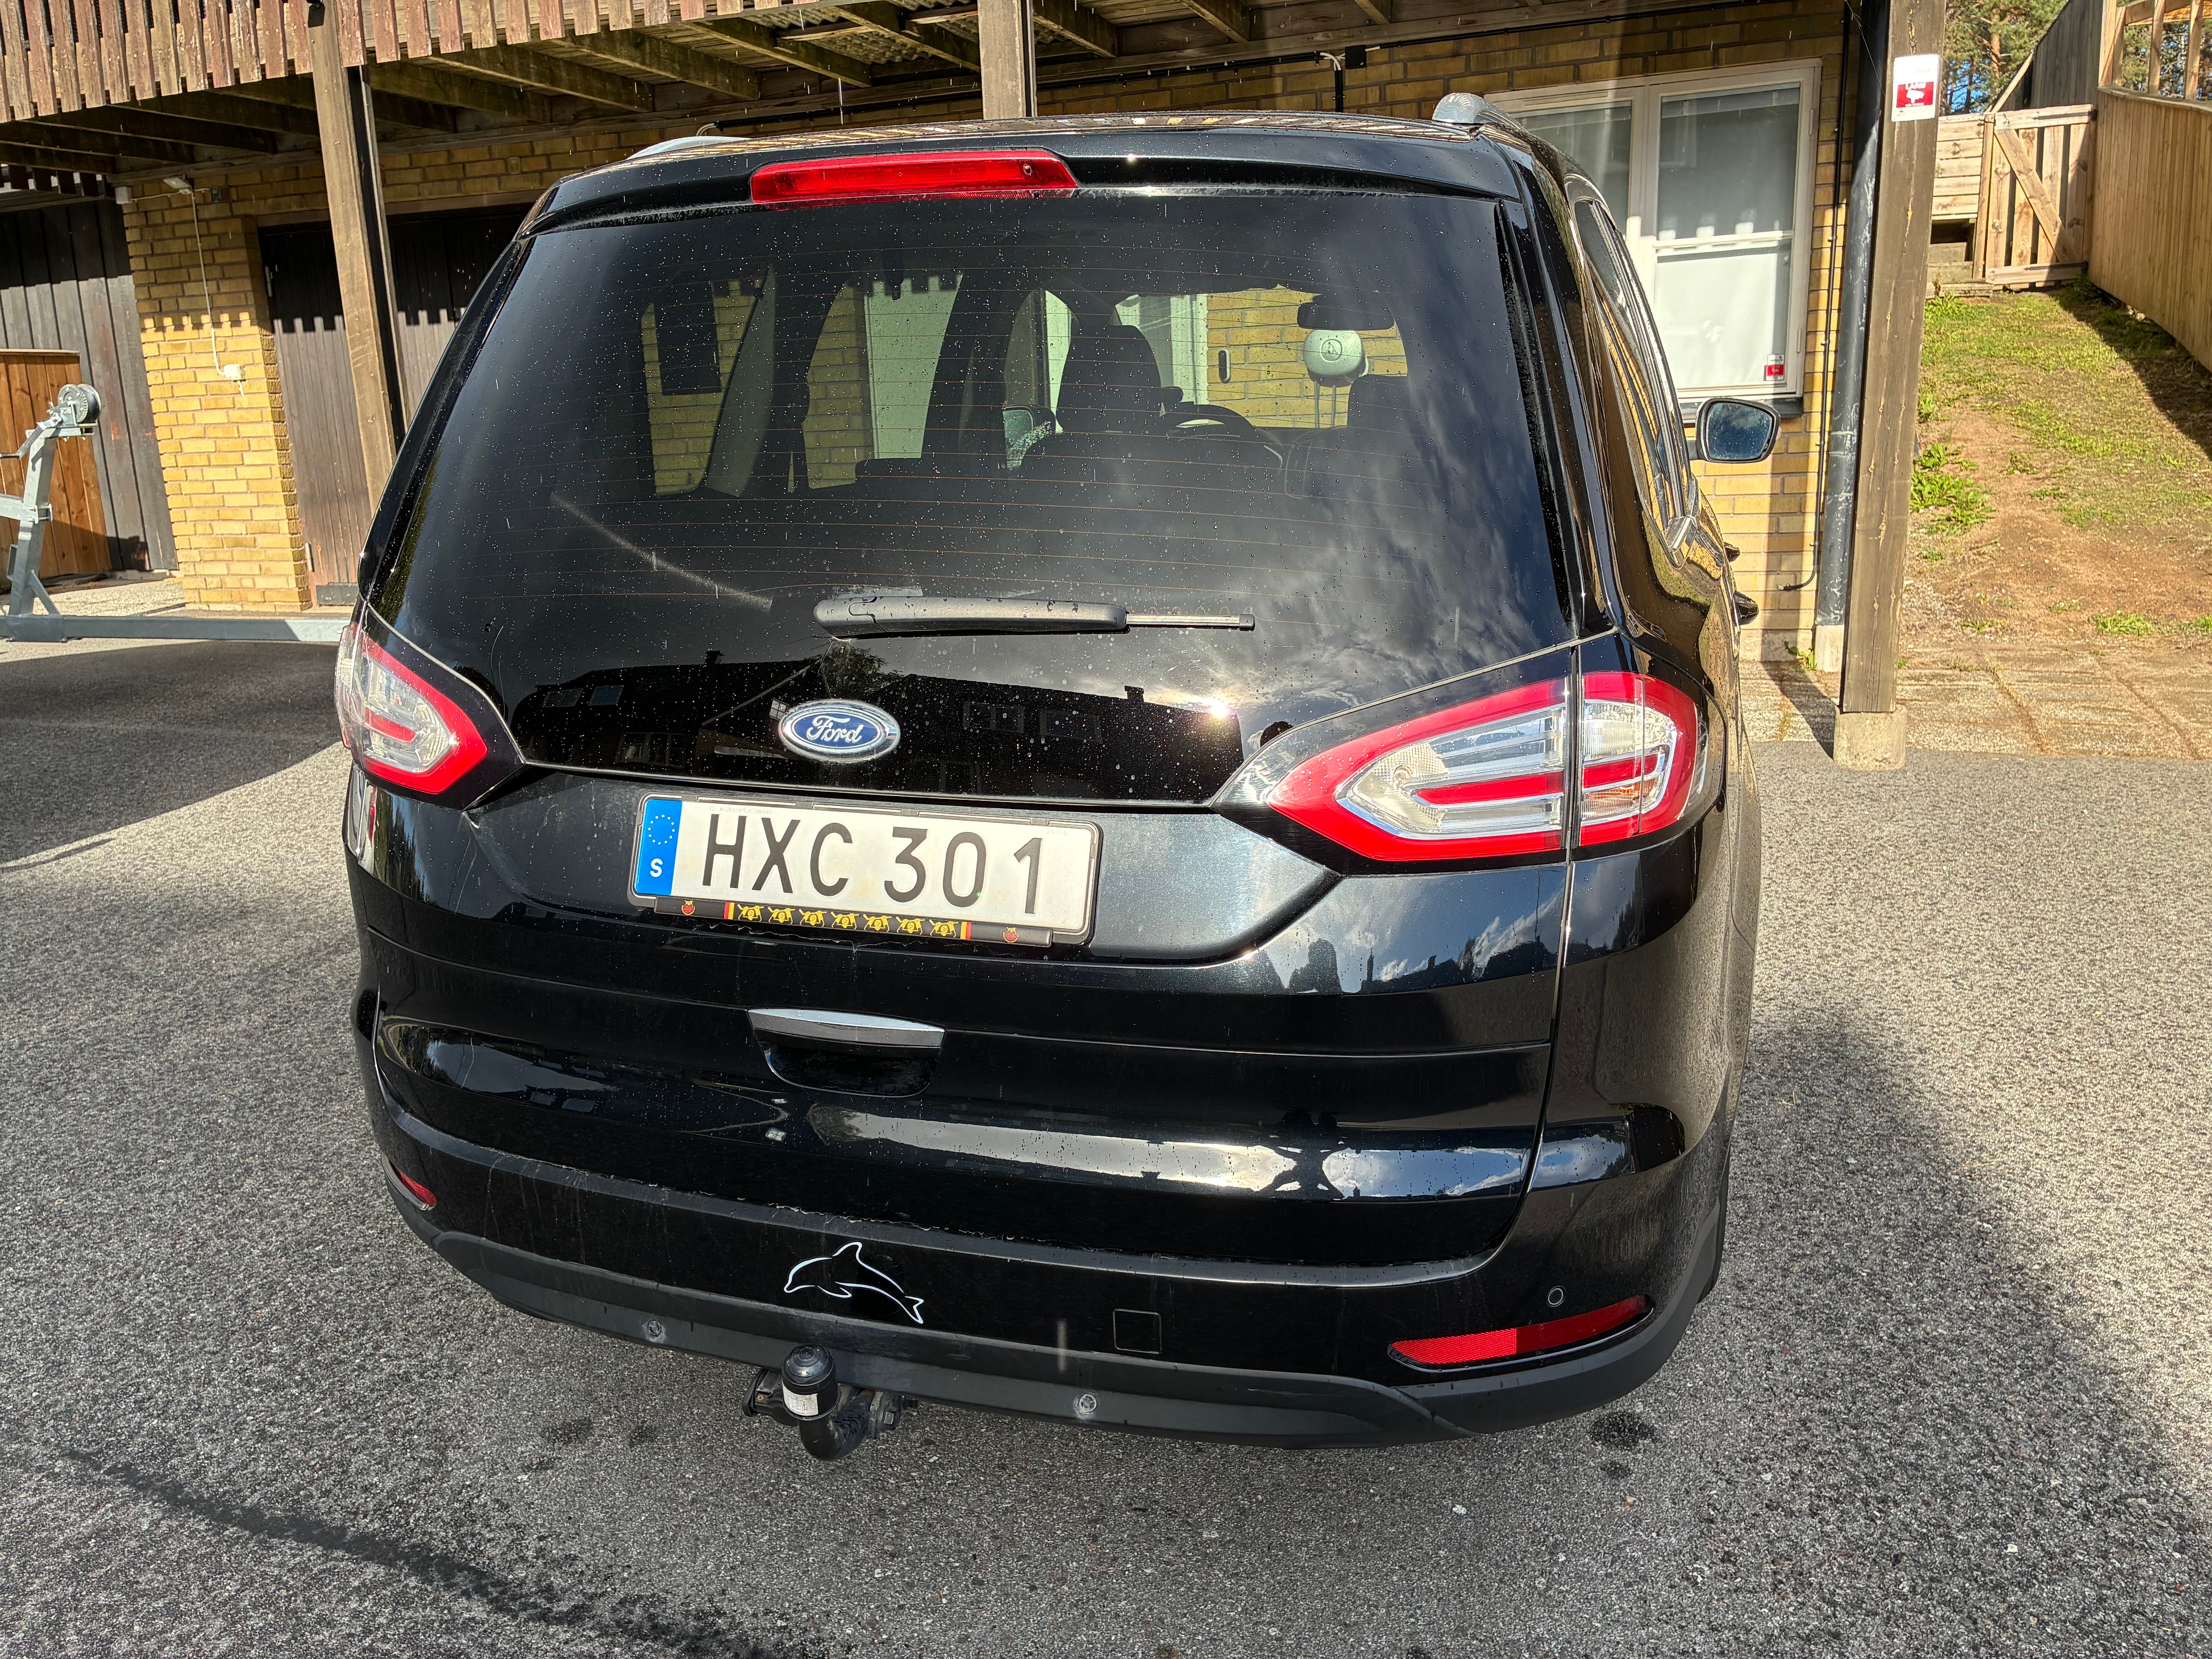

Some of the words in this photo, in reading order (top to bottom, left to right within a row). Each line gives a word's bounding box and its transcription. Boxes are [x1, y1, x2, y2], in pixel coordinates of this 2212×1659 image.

[806, 715, 864, 743] Ford
[650, 858, 663, 878] S
[702, 814, 853, 896] HXC
[884, 827, 1043, 914] 301
